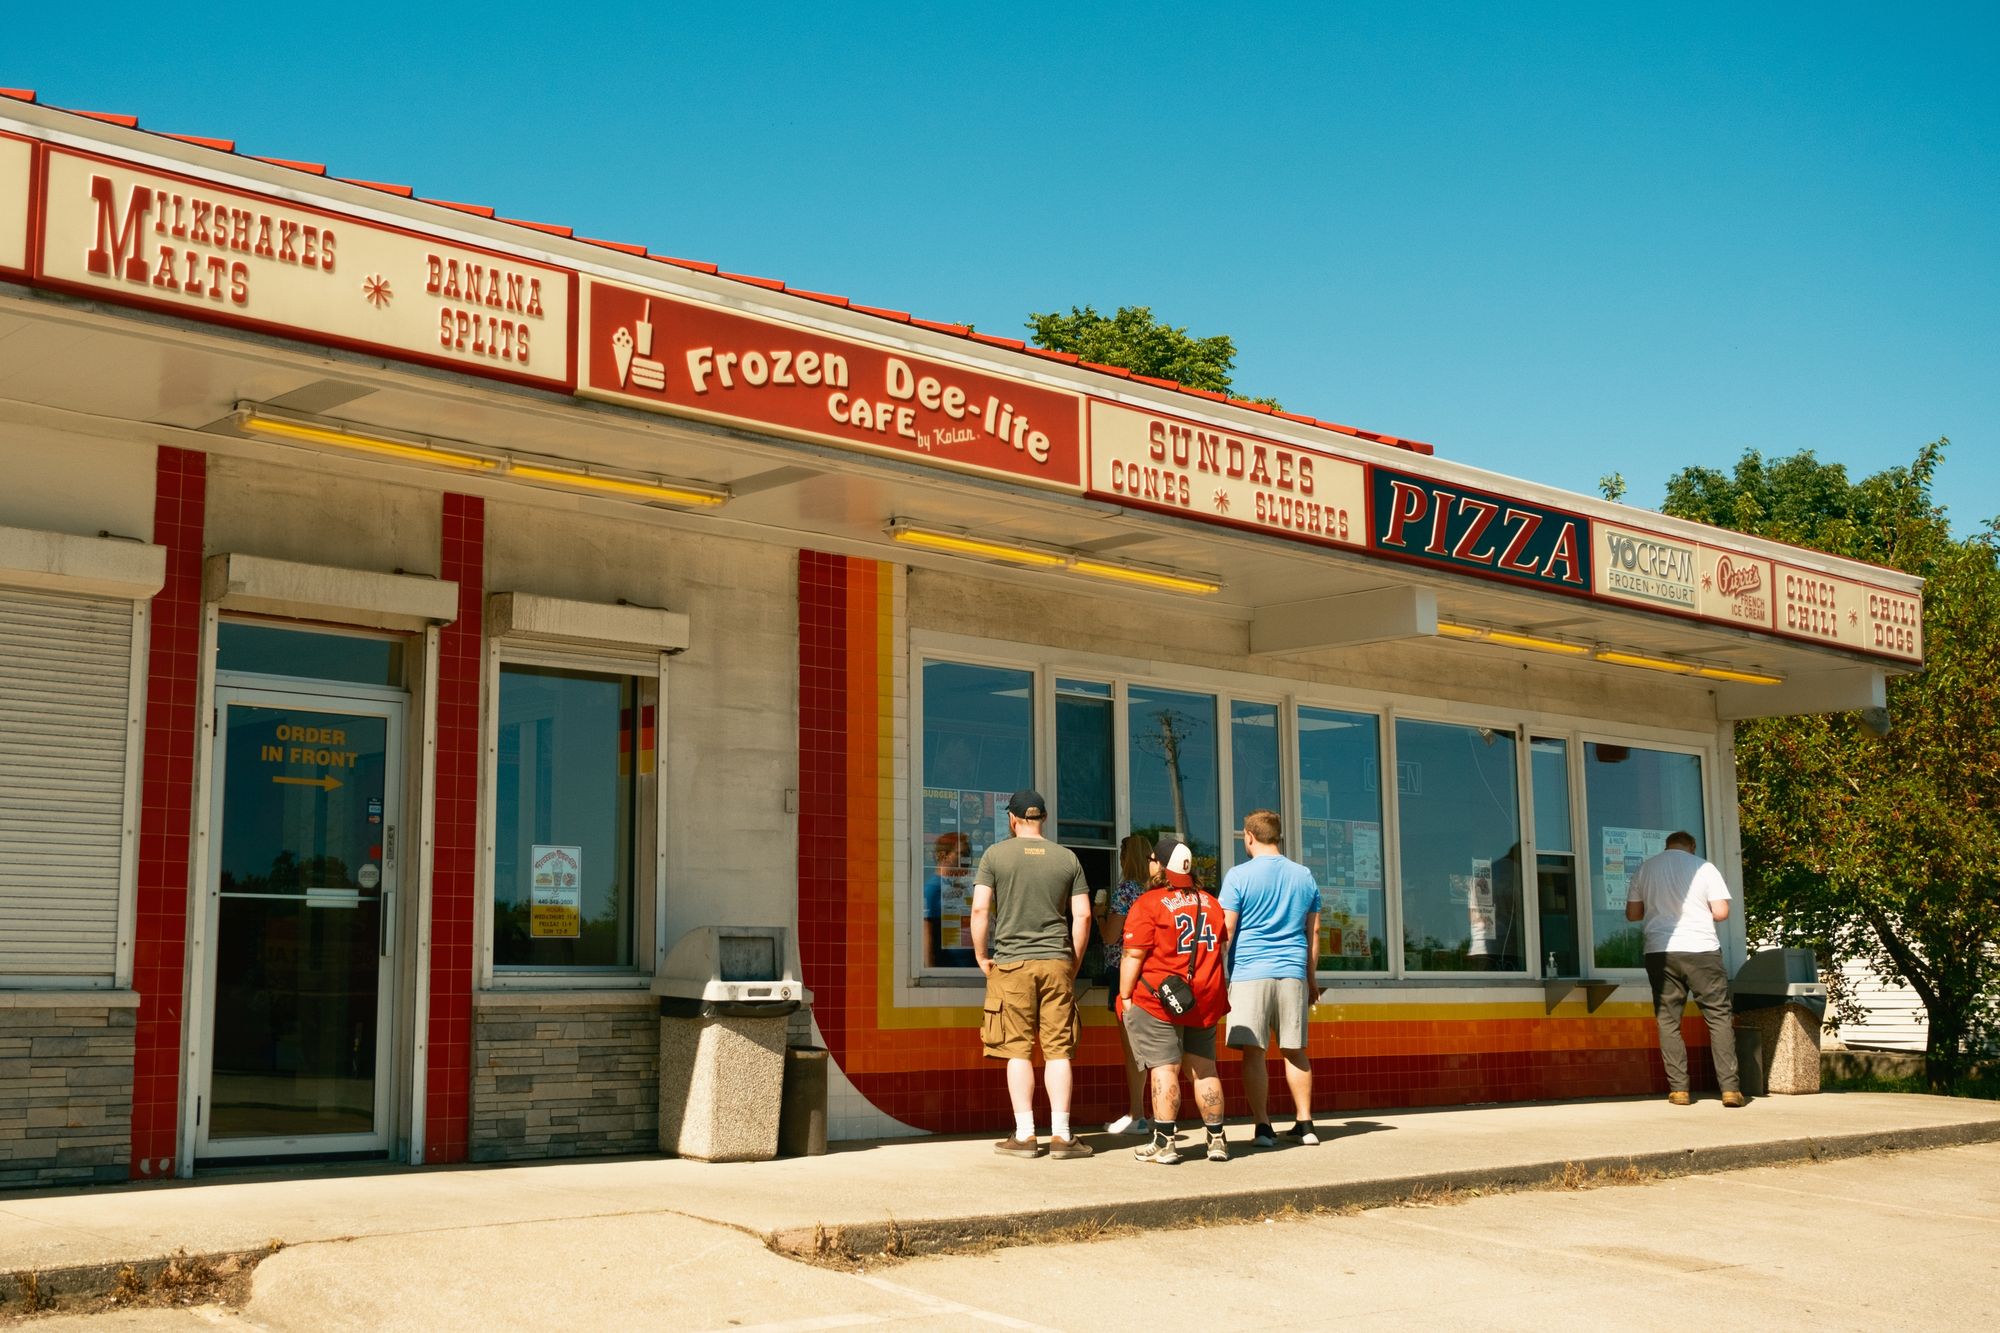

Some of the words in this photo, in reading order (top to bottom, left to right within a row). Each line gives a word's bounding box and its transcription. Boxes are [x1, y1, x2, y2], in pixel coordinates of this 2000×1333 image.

[88, 175, 336, 282] MILKSHAKES
[427, 254, 543, 316] BANANA
[441, 307, 529, 362] SPLITS
[686, 346, 849, 393] Frozen
[886, 357, 1050, 463] Dee-lite
[827, 392, 916, 438] CAFE
[917, 431, 931, 451] by
[1149, 420, 1314, 495] SUNDAES
[1111, 458, 1190, 505] CONES
[1255, 491, 1349, 538] SLUSHES
[1382, 480, 1584, 584] PIZZA
[1609, 572, 1649, 592] FROZEN
[1655, 582, 1695, 602] YOGURT
[1716, 554, 1761, 597] Pierre's
[1786, 574, 1836, 609] CINCI
[1731, 603, 1742, 616] ICE
[1744, 607, 1765, 620] CREAM
[1740, 594, 1765, 609] FRENCH
[1787, 603, 1838, 638] CHILI
[1869, 594, 1916, 627] CHILI
[1874, 622, 1914, 653] DOGS
[276, 724, 346, 745] ORDER
[261, 745, 283, 762] IN
[290, 747, 358, 768] FRONT
[1183, 858, 1190, 871] C
[1174, 912, 1218, 955] 24
